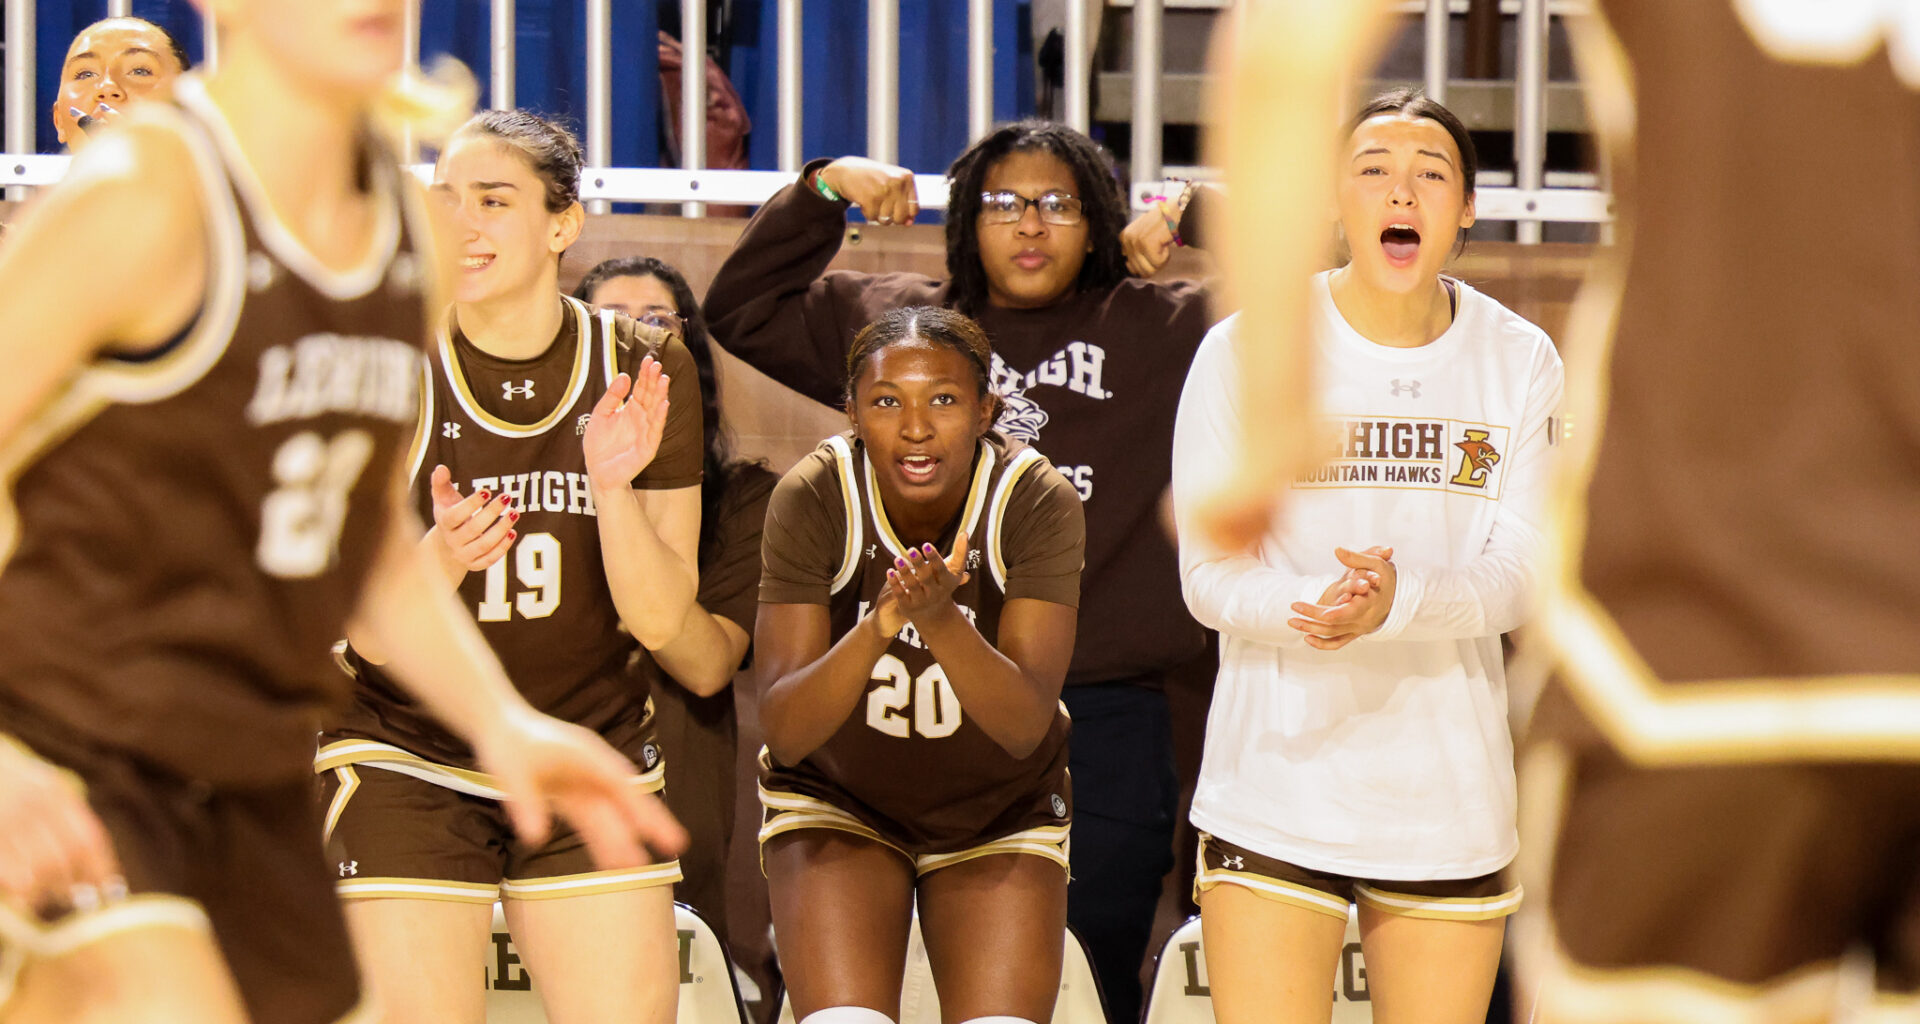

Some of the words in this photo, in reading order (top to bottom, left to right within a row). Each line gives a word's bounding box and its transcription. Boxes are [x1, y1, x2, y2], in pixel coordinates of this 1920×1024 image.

[1333, 422, 1443, 459] HIGH
[1385, 466, 1441, 484] HAWKS
[478, 532, 562, 622] 19
[866, 653, 962, 739] 20
